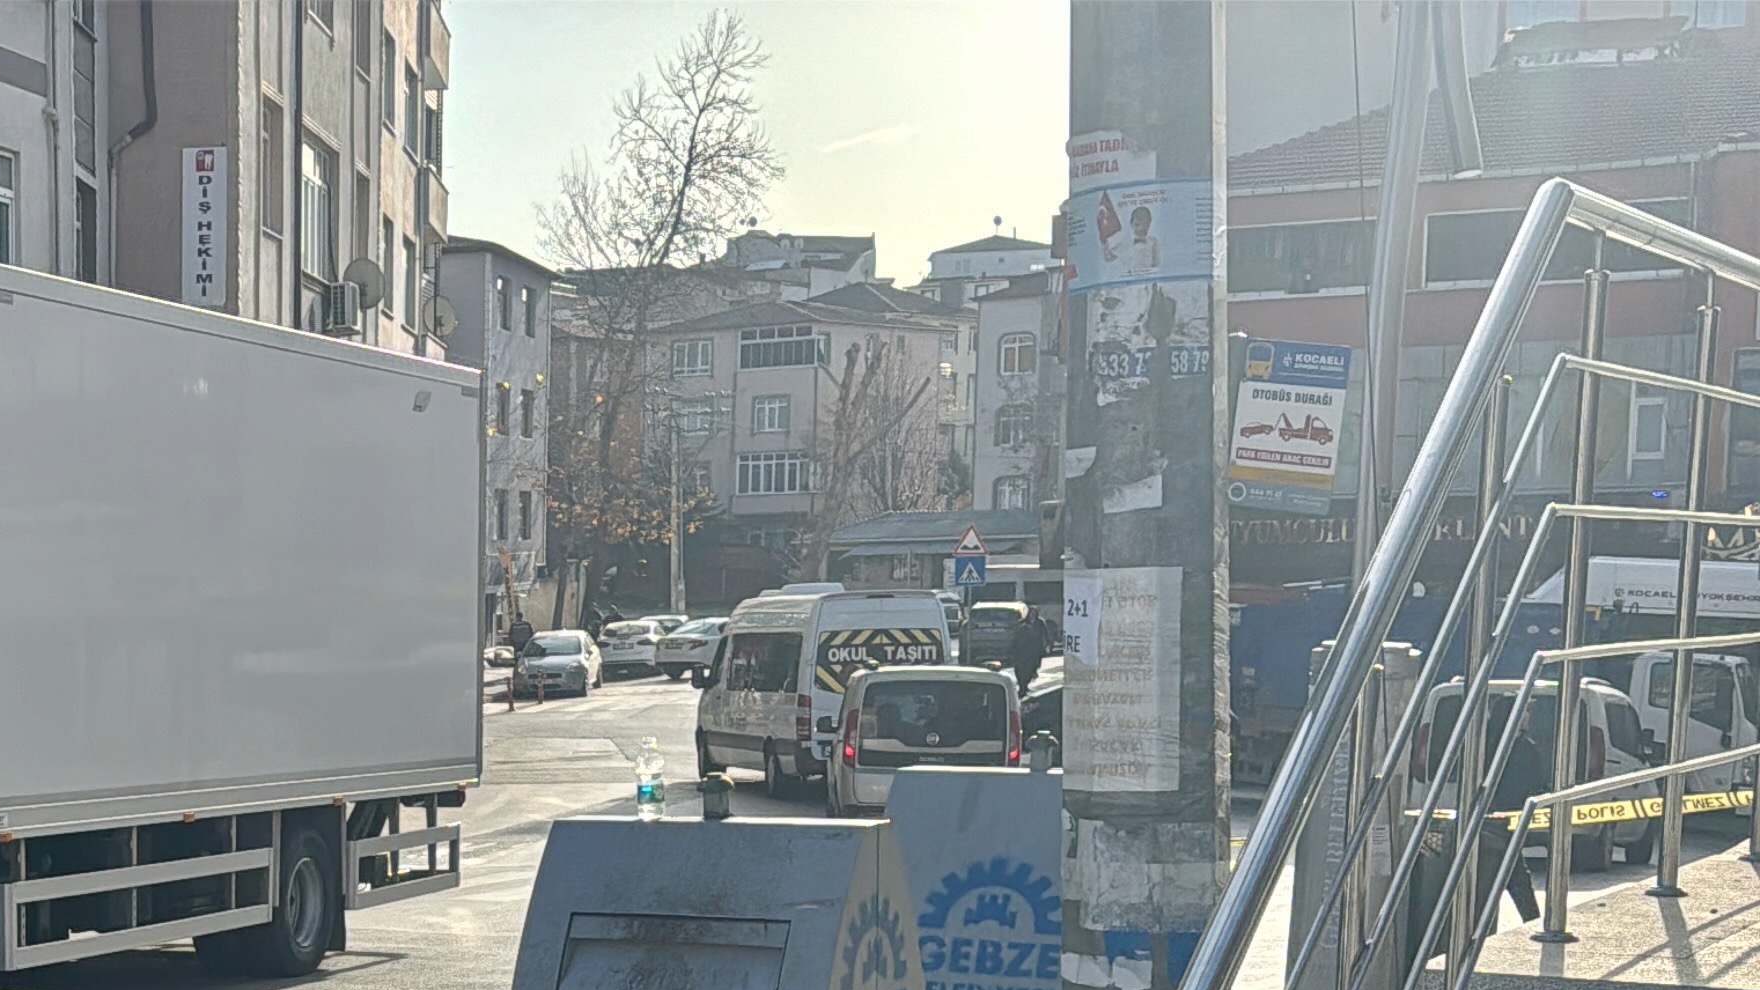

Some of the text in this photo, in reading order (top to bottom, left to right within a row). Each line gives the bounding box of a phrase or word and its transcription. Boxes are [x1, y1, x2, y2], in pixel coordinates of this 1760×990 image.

[196, 175, 213, 297] DİŞ HEKİMİ
[1170, 350, 1189, 373] 58
[1252, 388, 1333, 406] OTOBÜS DURAĞI
[1067, 598, 1089, 618] 2+1
[828, 645, 937, 663] OKUL TAŞITI
[919, 935, 1063, 981] GEBZE
